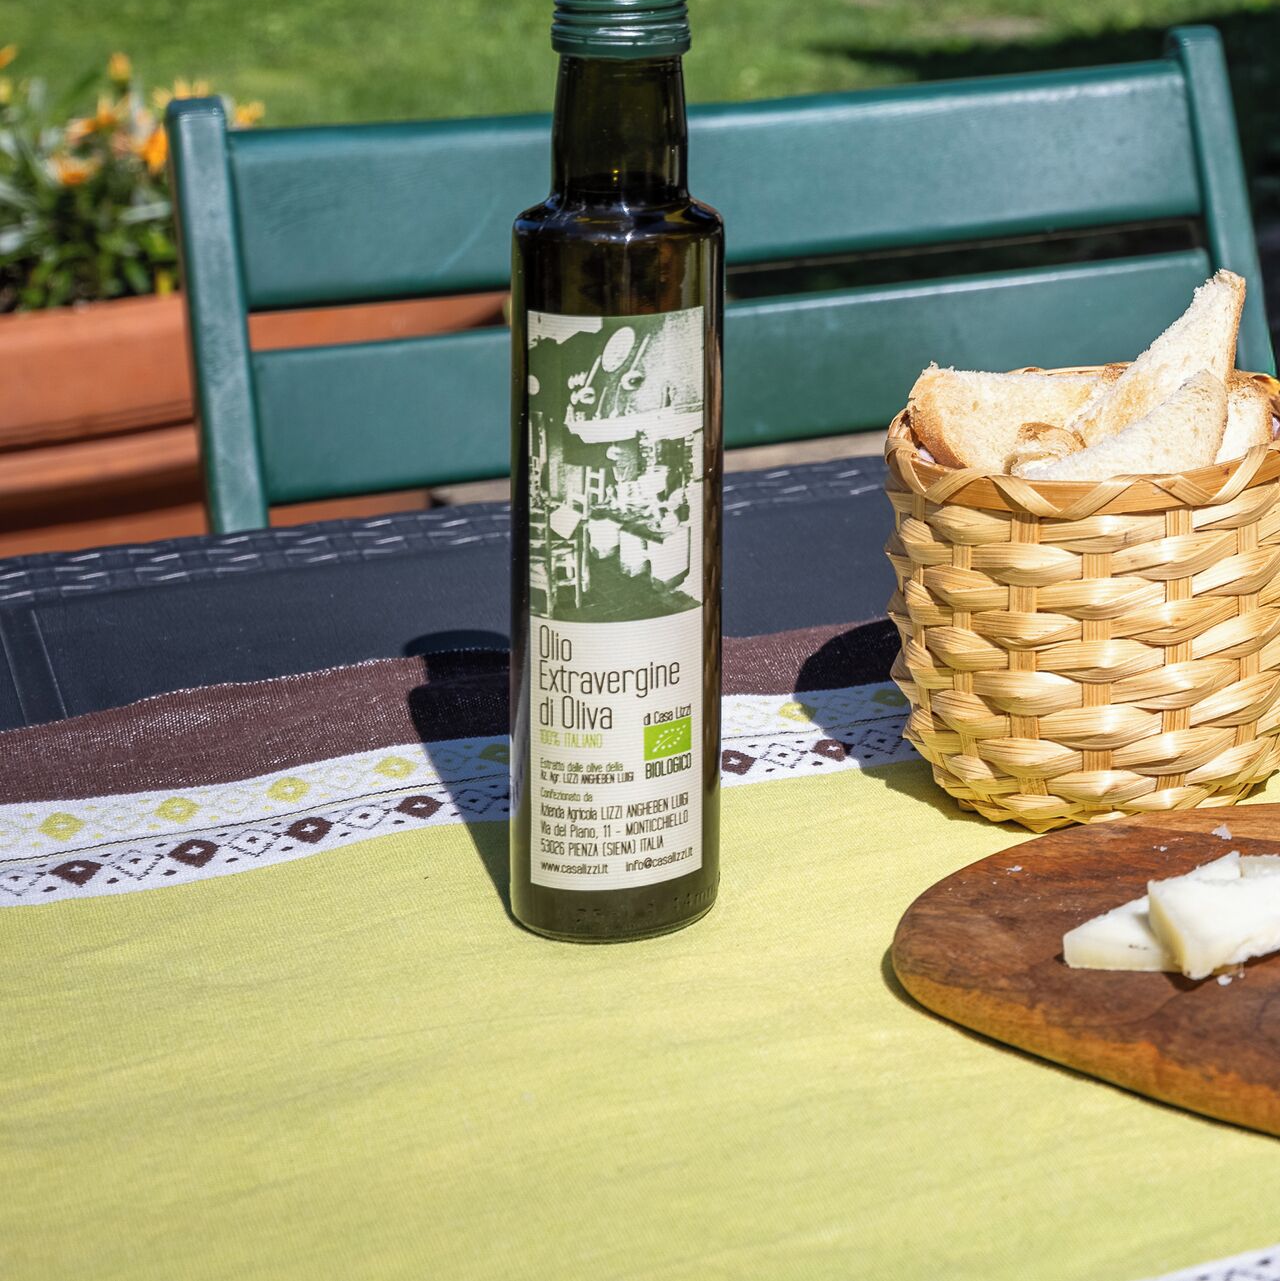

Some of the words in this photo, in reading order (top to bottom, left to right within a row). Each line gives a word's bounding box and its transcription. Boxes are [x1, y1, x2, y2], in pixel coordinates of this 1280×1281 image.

[539, 624, 573, 662] Olio
[539, 660, 680, 698] Extravergine
[539, 696, 554, 727] di
[562, 695, 613, 730] Oliva
[654, 711, 673, 724] Casa
[675, 703, 692, 719] Lizzi
[564, 731, 603, 749] ITALIANO
[586, 762, 603, 773] olive
[645, 752, 692, 780] BIOLOGICO
[567, 806, 598, 823] Agricola
[601, 805, 623, 820] LIZZI
[626, 798, 669, 818] ANGHEBEN
[671, 791, 689, 810] LUIGI
[583, 792, 593, 802] da
[554, 823, 567, 837] del
[570, 824, 598, 839] Piano,
[603, 824, 611, 838] 11
[625, 809, 689, 836] MONTICCHIELLO
[541, 837, 565, 856] 53026
[568, 842, 599, 857] PIENZA
[640, 835, 664, 852] ITALIA
[541, 861, 609, 875] www.casalizzi.it
[625, 846, 694, 872] info@casalizzi.it
